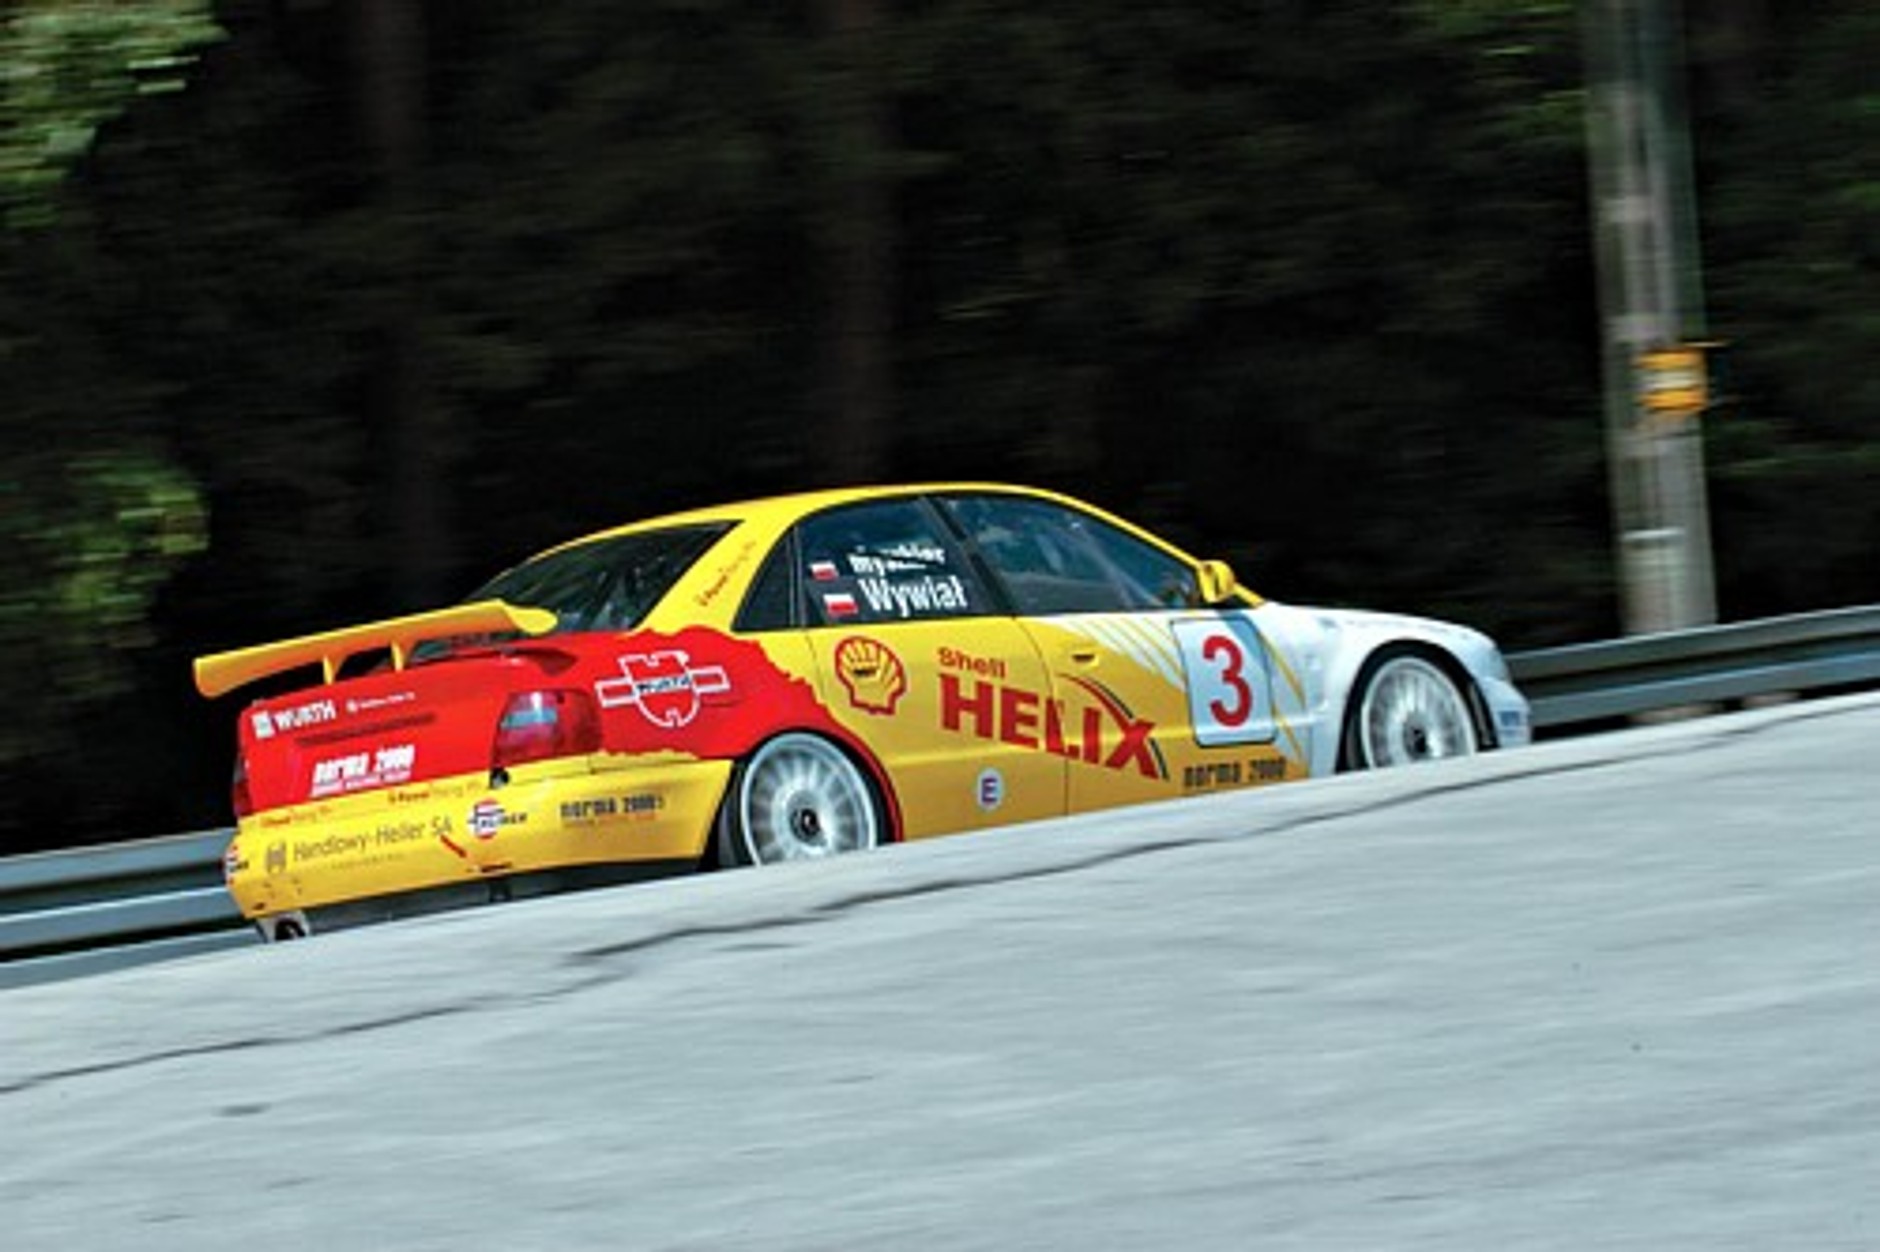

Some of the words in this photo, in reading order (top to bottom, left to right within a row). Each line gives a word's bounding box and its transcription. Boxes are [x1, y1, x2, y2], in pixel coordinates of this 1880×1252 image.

[858, 575, 968, 618] Wywiał
[939, 646, 1006, 679] Shell
[1202, 634, 1254, 728] 3
[939, 672, 1160, 780] HELIX
[981, 778, 998, 803] E
